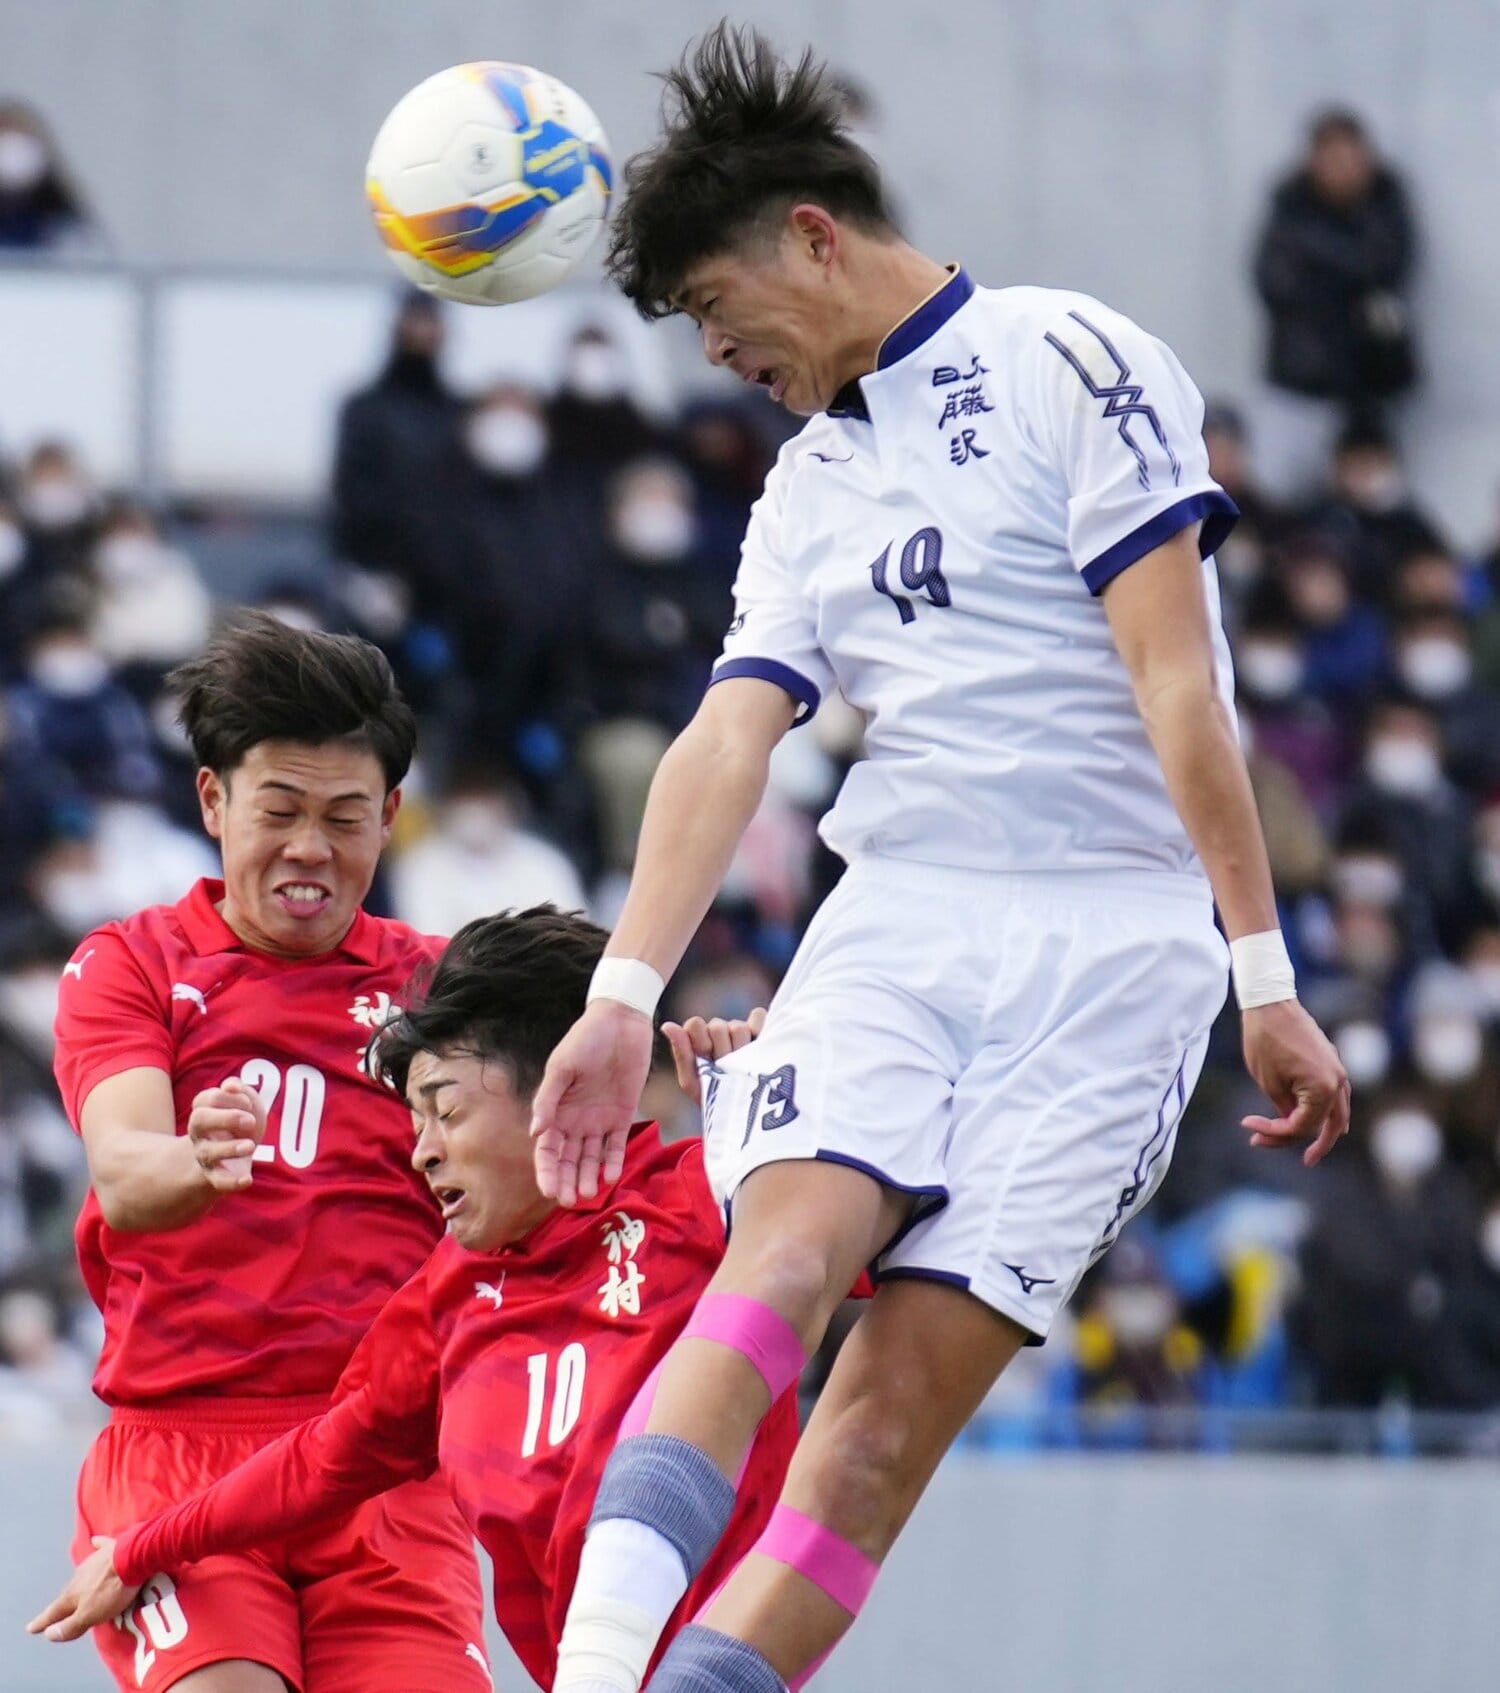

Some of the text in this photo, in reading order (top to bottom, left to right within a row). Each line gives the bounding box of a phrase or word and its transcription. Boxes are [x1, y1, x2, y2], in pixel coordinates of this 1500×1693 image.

[869, 526, 952, 625] 19
[240, 1058, 326, 1169] 20
[598, 1211, 646, 1317] 神村
[521, 1342, 587, 1458] 10
